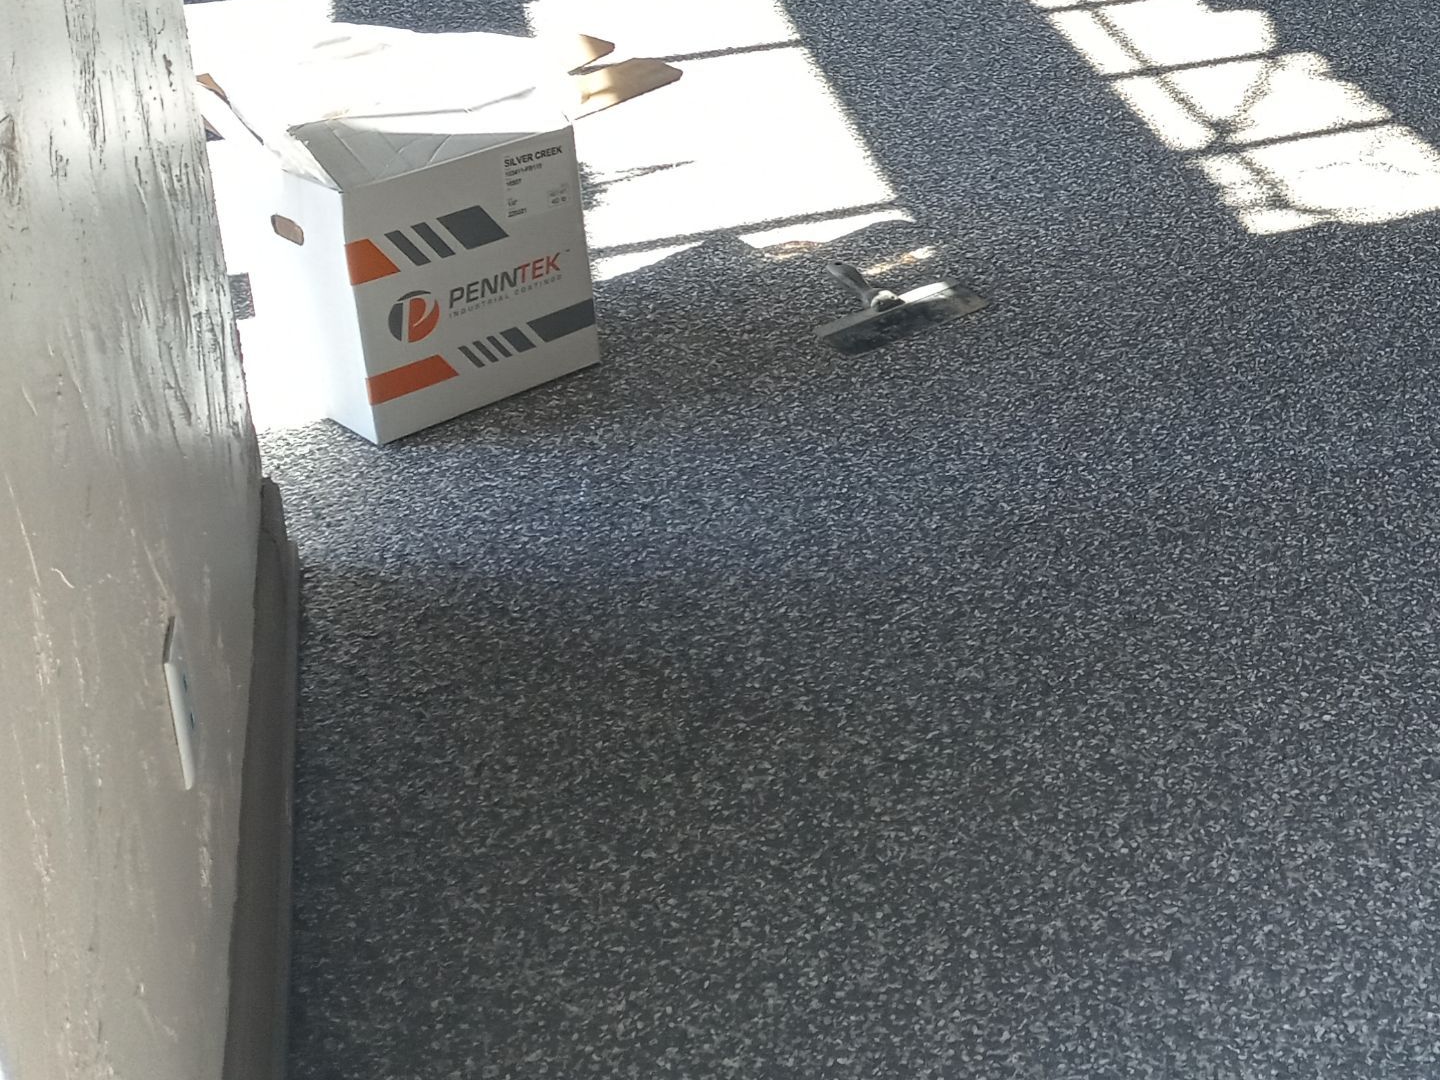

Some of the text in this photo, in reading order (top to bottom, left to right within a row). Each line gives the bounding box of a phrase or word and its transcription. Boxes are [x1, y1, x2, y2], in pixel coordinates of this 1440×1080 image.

[503, 145, 563, 168] SILVER CREEK
[448, 251, 561, 309] PENNTEK
[448, 274, 563, 319] INDUSTRIAL COATINGS
